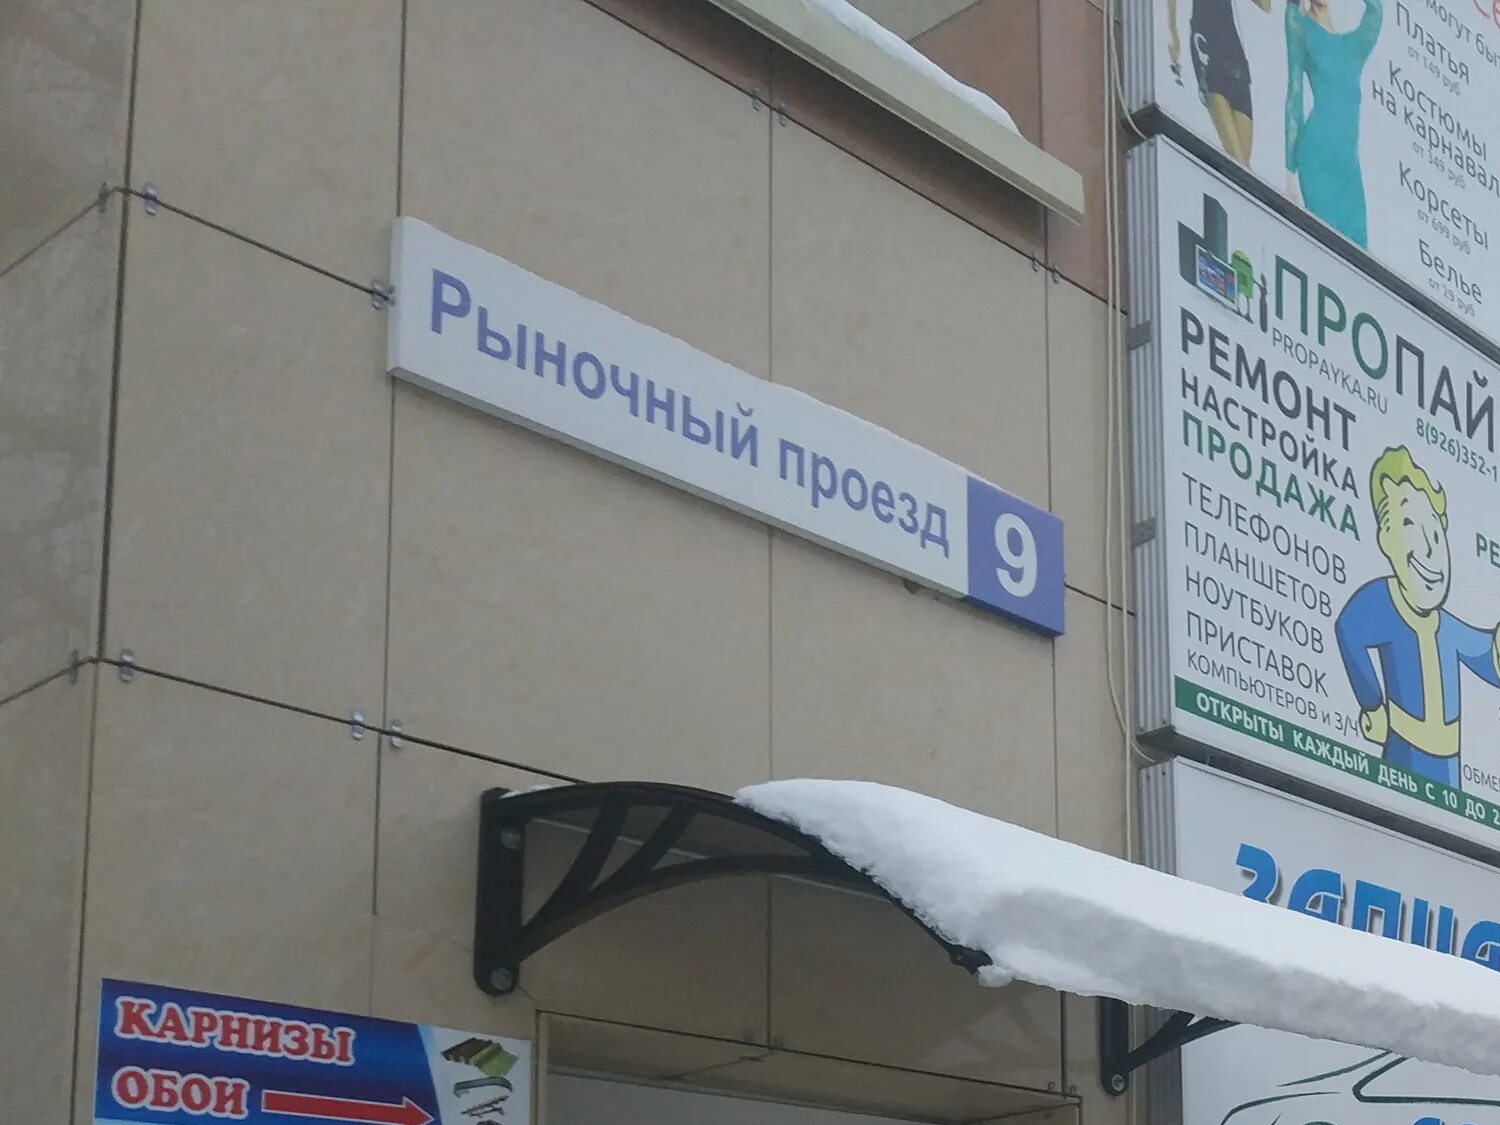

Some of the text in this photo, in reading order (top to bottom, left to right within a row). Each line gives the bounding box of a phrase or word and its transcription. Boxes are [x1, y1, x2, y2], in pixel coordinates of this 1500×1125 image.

[1396, 1, 1469, 85] Платья
[1407, 45, 1420, 61] от
[1372, 80, 1500, 197] на карнавал
[1389, 59, 1488, 161] Костюмы
[1399, 160, 1488, 250] Корсеты
[1418, 238, 1482, 305] Белье
[1180, 306, 1357, 450] РЕМОНТ
[1272, 327, 1388, 414] PROPAYKA.RU
[431, 268, 1037, 598] Рыночный проезд 9
[1181, 367, 1359, 499] НАСТРОЙКА
[1182, 410, 1361, 541] ПРОДАЖА
[1182, 472, 1347, 585] ТЕЛЕФОНОВ
[1183, 521, 1332, 618] ПЛАНШЕТОВ
[1184, 566, 1324, 655] НОУТБУКОВ
[1186, 610, 1329, 698] ПРИСТАВОК
[1187, 648, 1317, 720] КОМПЬЮТЕРОВ
[1196, 691, 1285, 743] ОТКРЫТЫ
[1292, 728, 1370, 776] КАЖДЫЙ
[1377, 764, 1418, 794] ДЕНЬ
[1425, 783, 1434, 800] С
[1442, 788, 1457, 808] 10
[1465, 797, 1485, 820] ДО
[115, 996, 355, 1066] КАРНИЗЫ
[112, 1066, 250, 1119] ОБОИ
